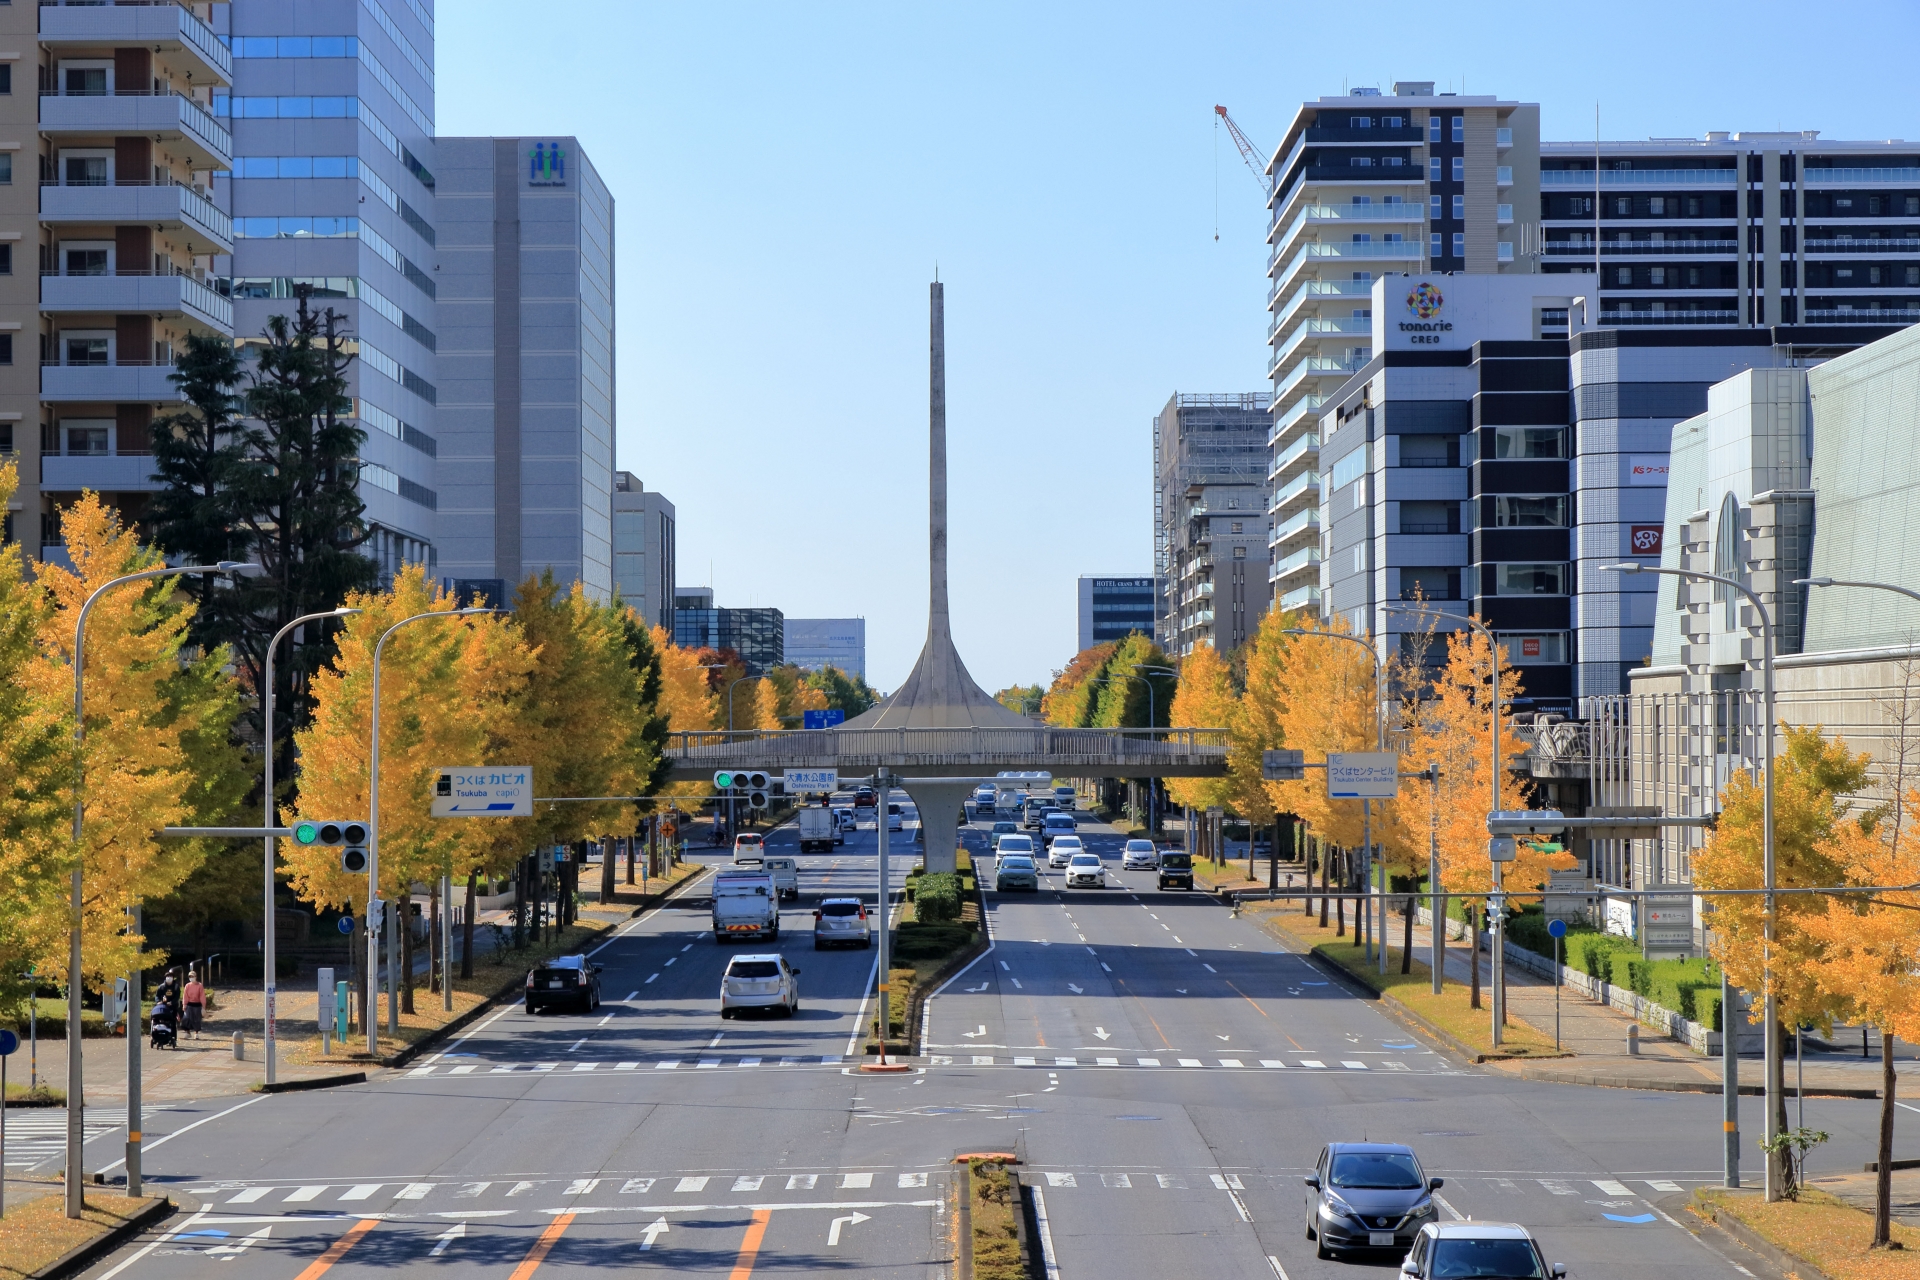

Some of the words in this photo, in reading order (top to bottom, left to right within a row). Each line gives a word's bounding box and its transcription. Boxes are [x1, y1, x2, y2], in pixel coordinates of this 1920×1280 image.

[1398, 320, 1453, 331] tonarie
[1411, 335, 1440, 343] CREO
[1331, 766, 1395, 776] つくばセンタービル
[786, 772, 835, 783] 大清水公園前
[455, 789, 488, 798] Tsukuba
